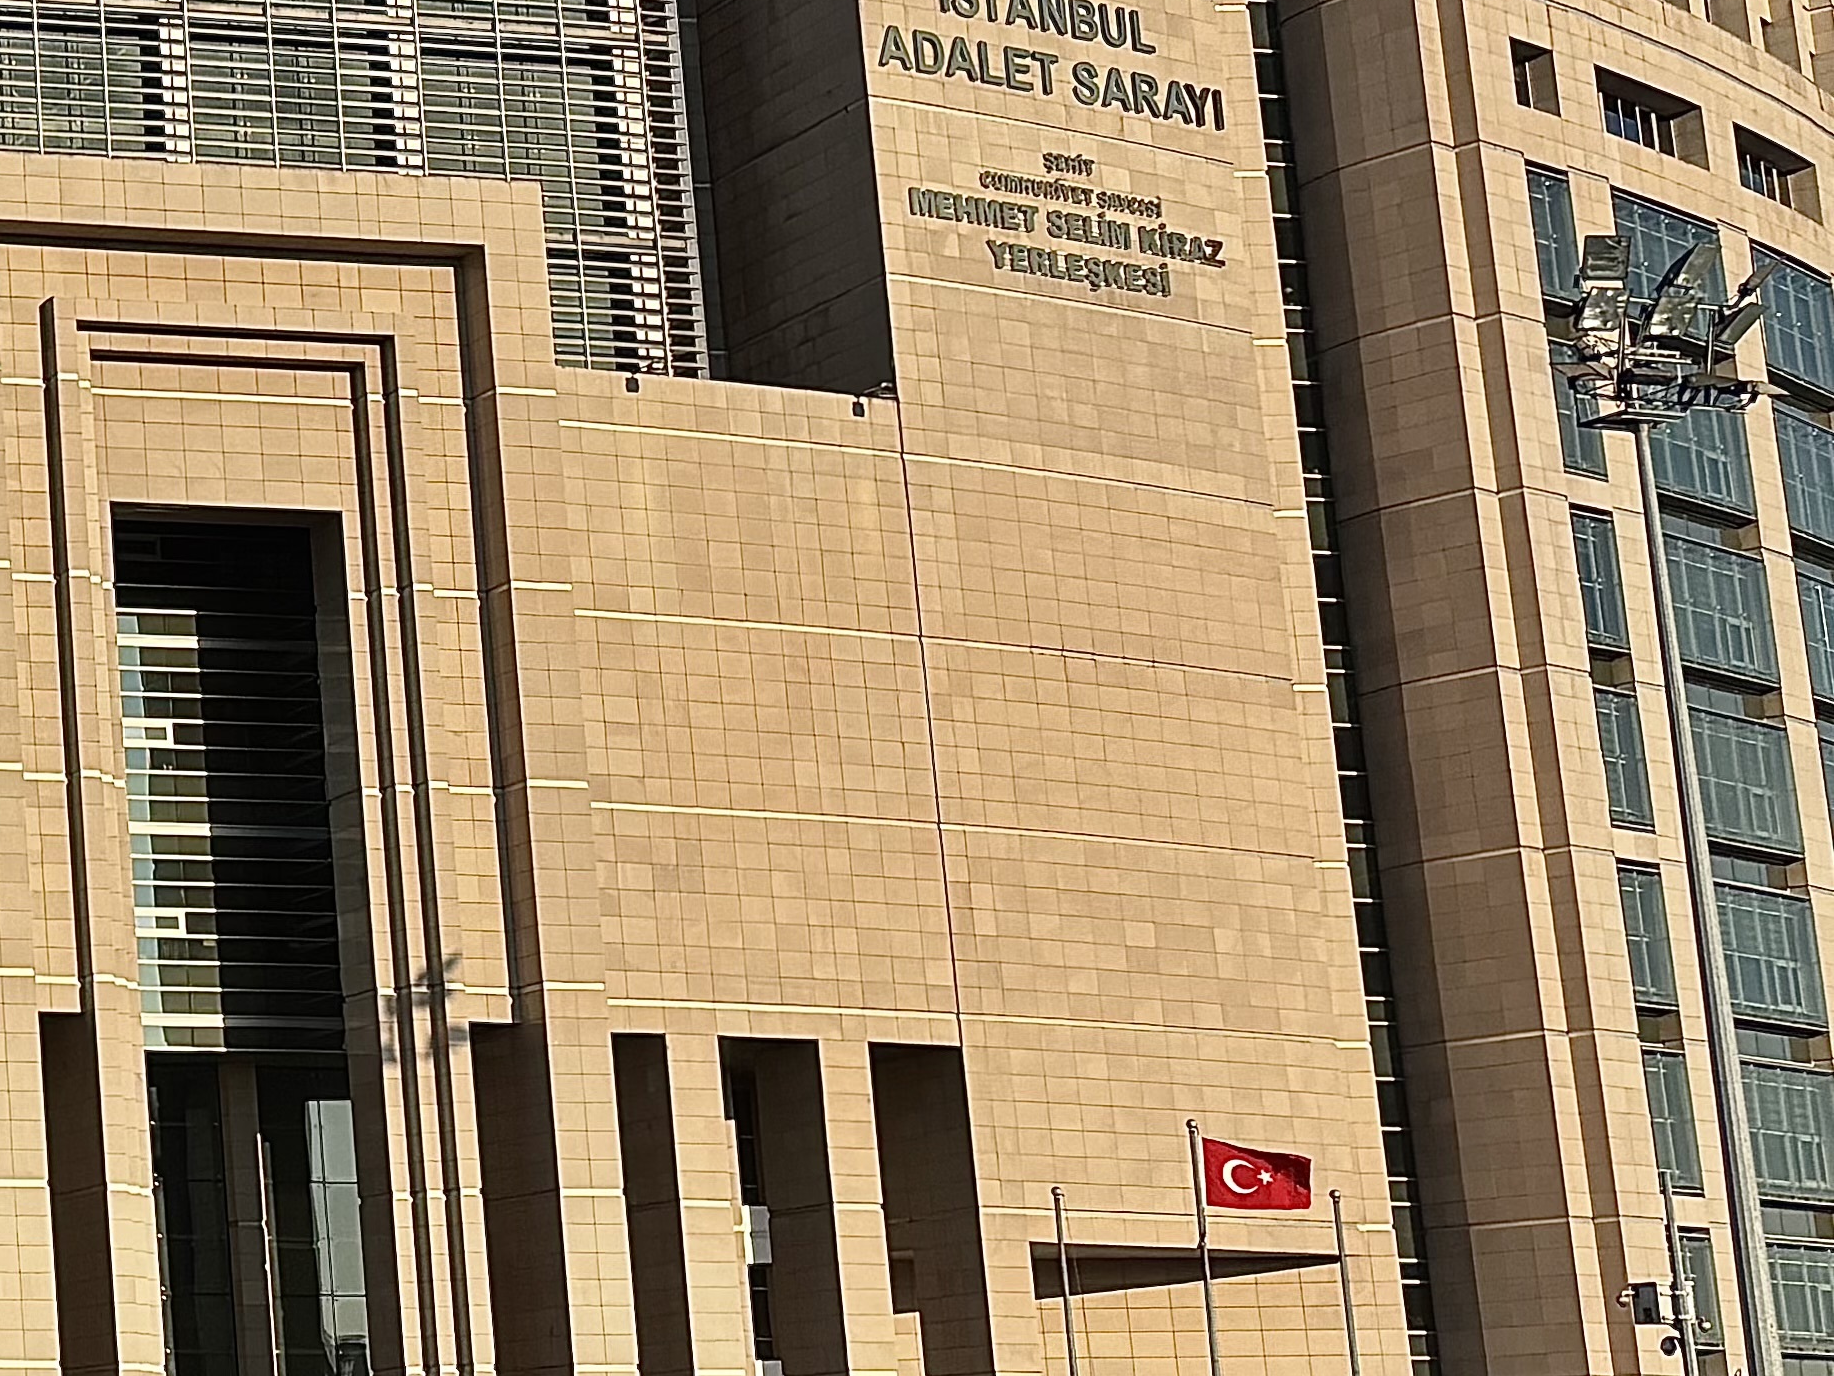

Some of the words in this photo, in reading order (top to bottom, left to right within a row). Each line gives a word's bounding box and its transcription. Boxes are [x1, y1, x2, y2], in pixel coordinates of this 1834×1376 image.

[878, 24, 1060, 96] ADALET
[1071, 60, 1226, 132] SARAYI
[908, 185, 1041, 237] MEHMET
[1045, 208, 1132, 252] SELİM
[1138, 222, 1227, 267] KİRAZ
[986, 239, 1172, 297] YERLEŞKESİ
